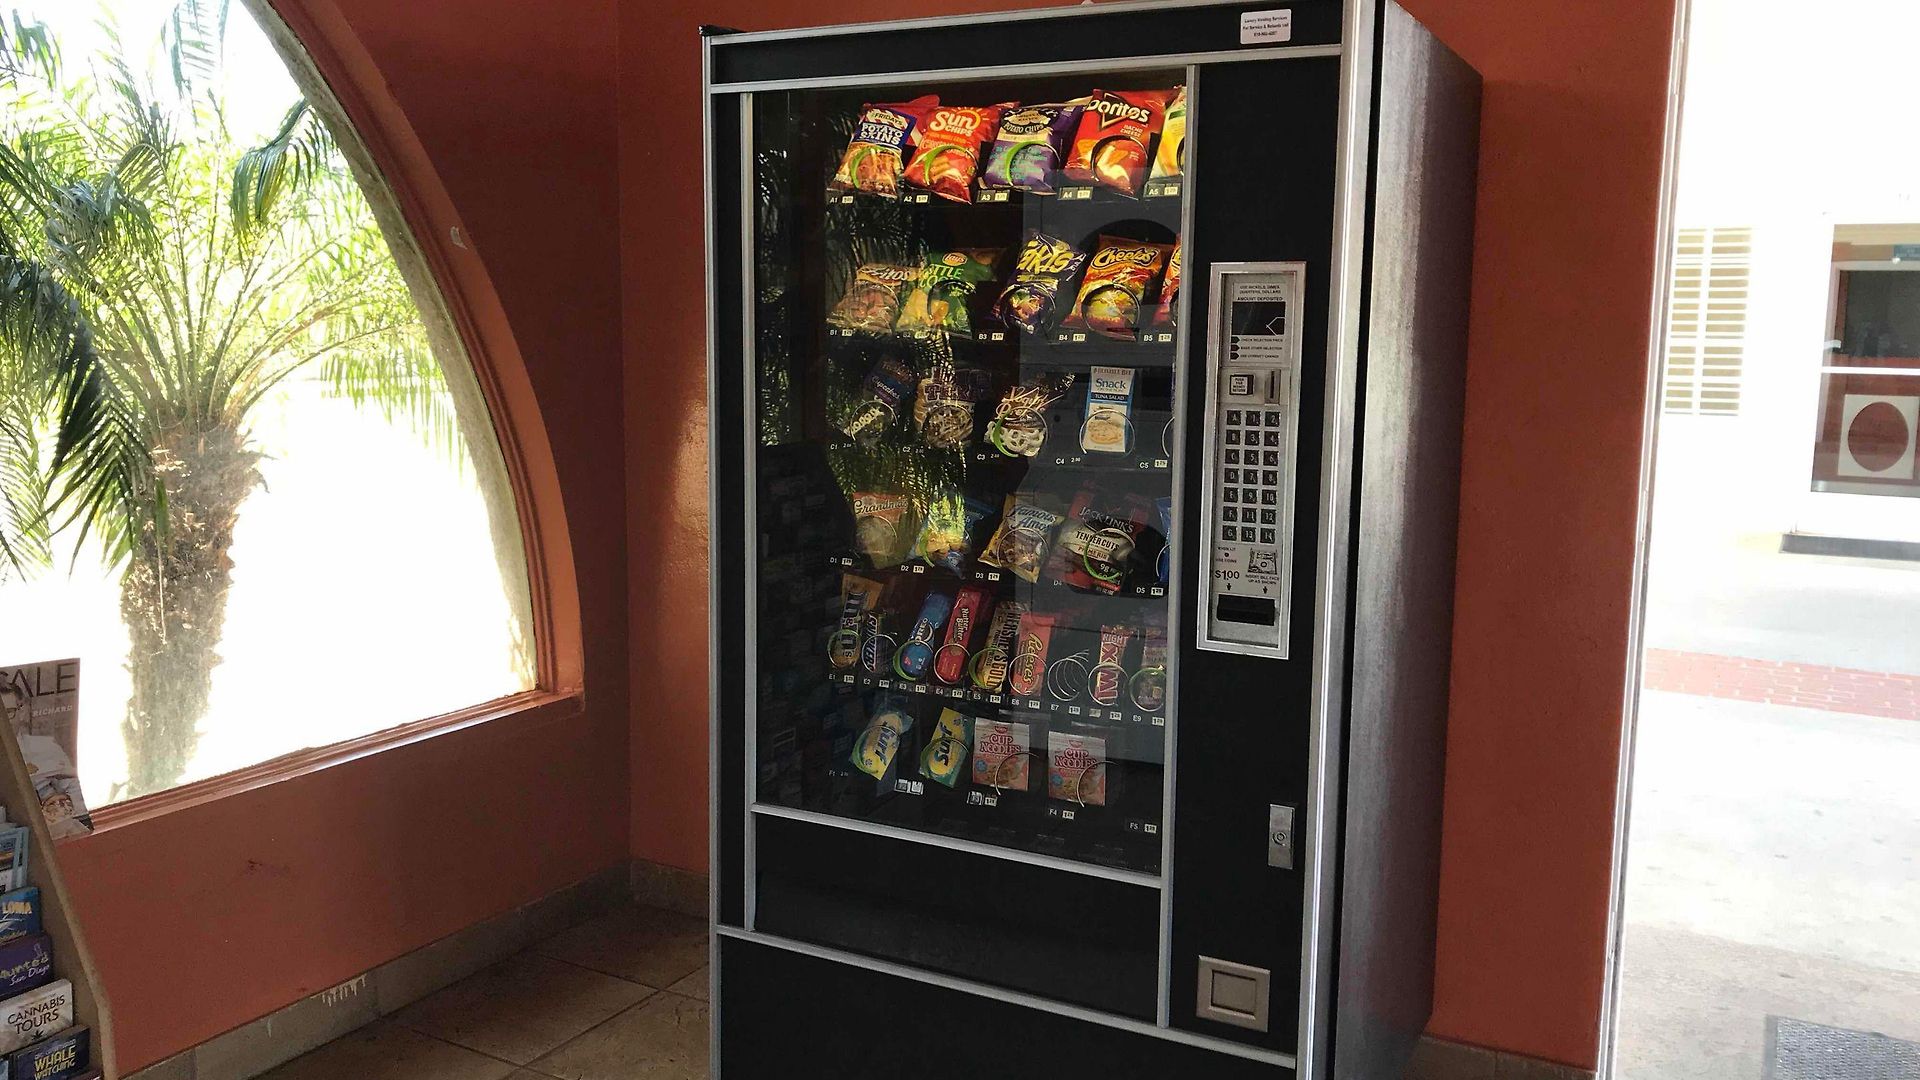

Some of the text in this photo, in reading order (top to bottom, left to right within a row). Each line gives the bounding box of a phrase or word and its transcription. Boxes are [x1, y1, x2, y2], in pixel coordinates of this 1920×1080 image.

[929, 111, 974, 132] Sun
[1087, 100, 1151, 123] Doritos
[862, 123, 904, 138] POTATO
[944, 125, 974, 138] CHIPS
[1003, 121, 1045, 134] POTATO CHIPS
[1120, 128, 1142, 138] CHEESE
[859, 132, 902, 146] SKINS
[1095, 378, 1126, 389] Snack
[1079, 506, 1134, 533] JACK LINK'S
[955, 617, 964, 641] Butter
[960, 607, 969, 631] Nutter
[1103, 633, 1129, 648] RIGHT
[1022, 632, 1043, 685] Reese's
[986, 658, 1008, 693] GOLD
[933, 721, 953, 766] Surf
[980, 741, 1022, 755] NOODLES
[989, 733, 1014, 746] CUP
[1055, 755, 1098, 770] NOODLES
[1063, 747, 1089, 761] CUP
[9, 964, 50, 986] San Diego
[7, 994, 66, 1025] CANNABIS
[14, 1008, 60, 1035] TOURS
[34, 1044, 76, 1073] WHALE
